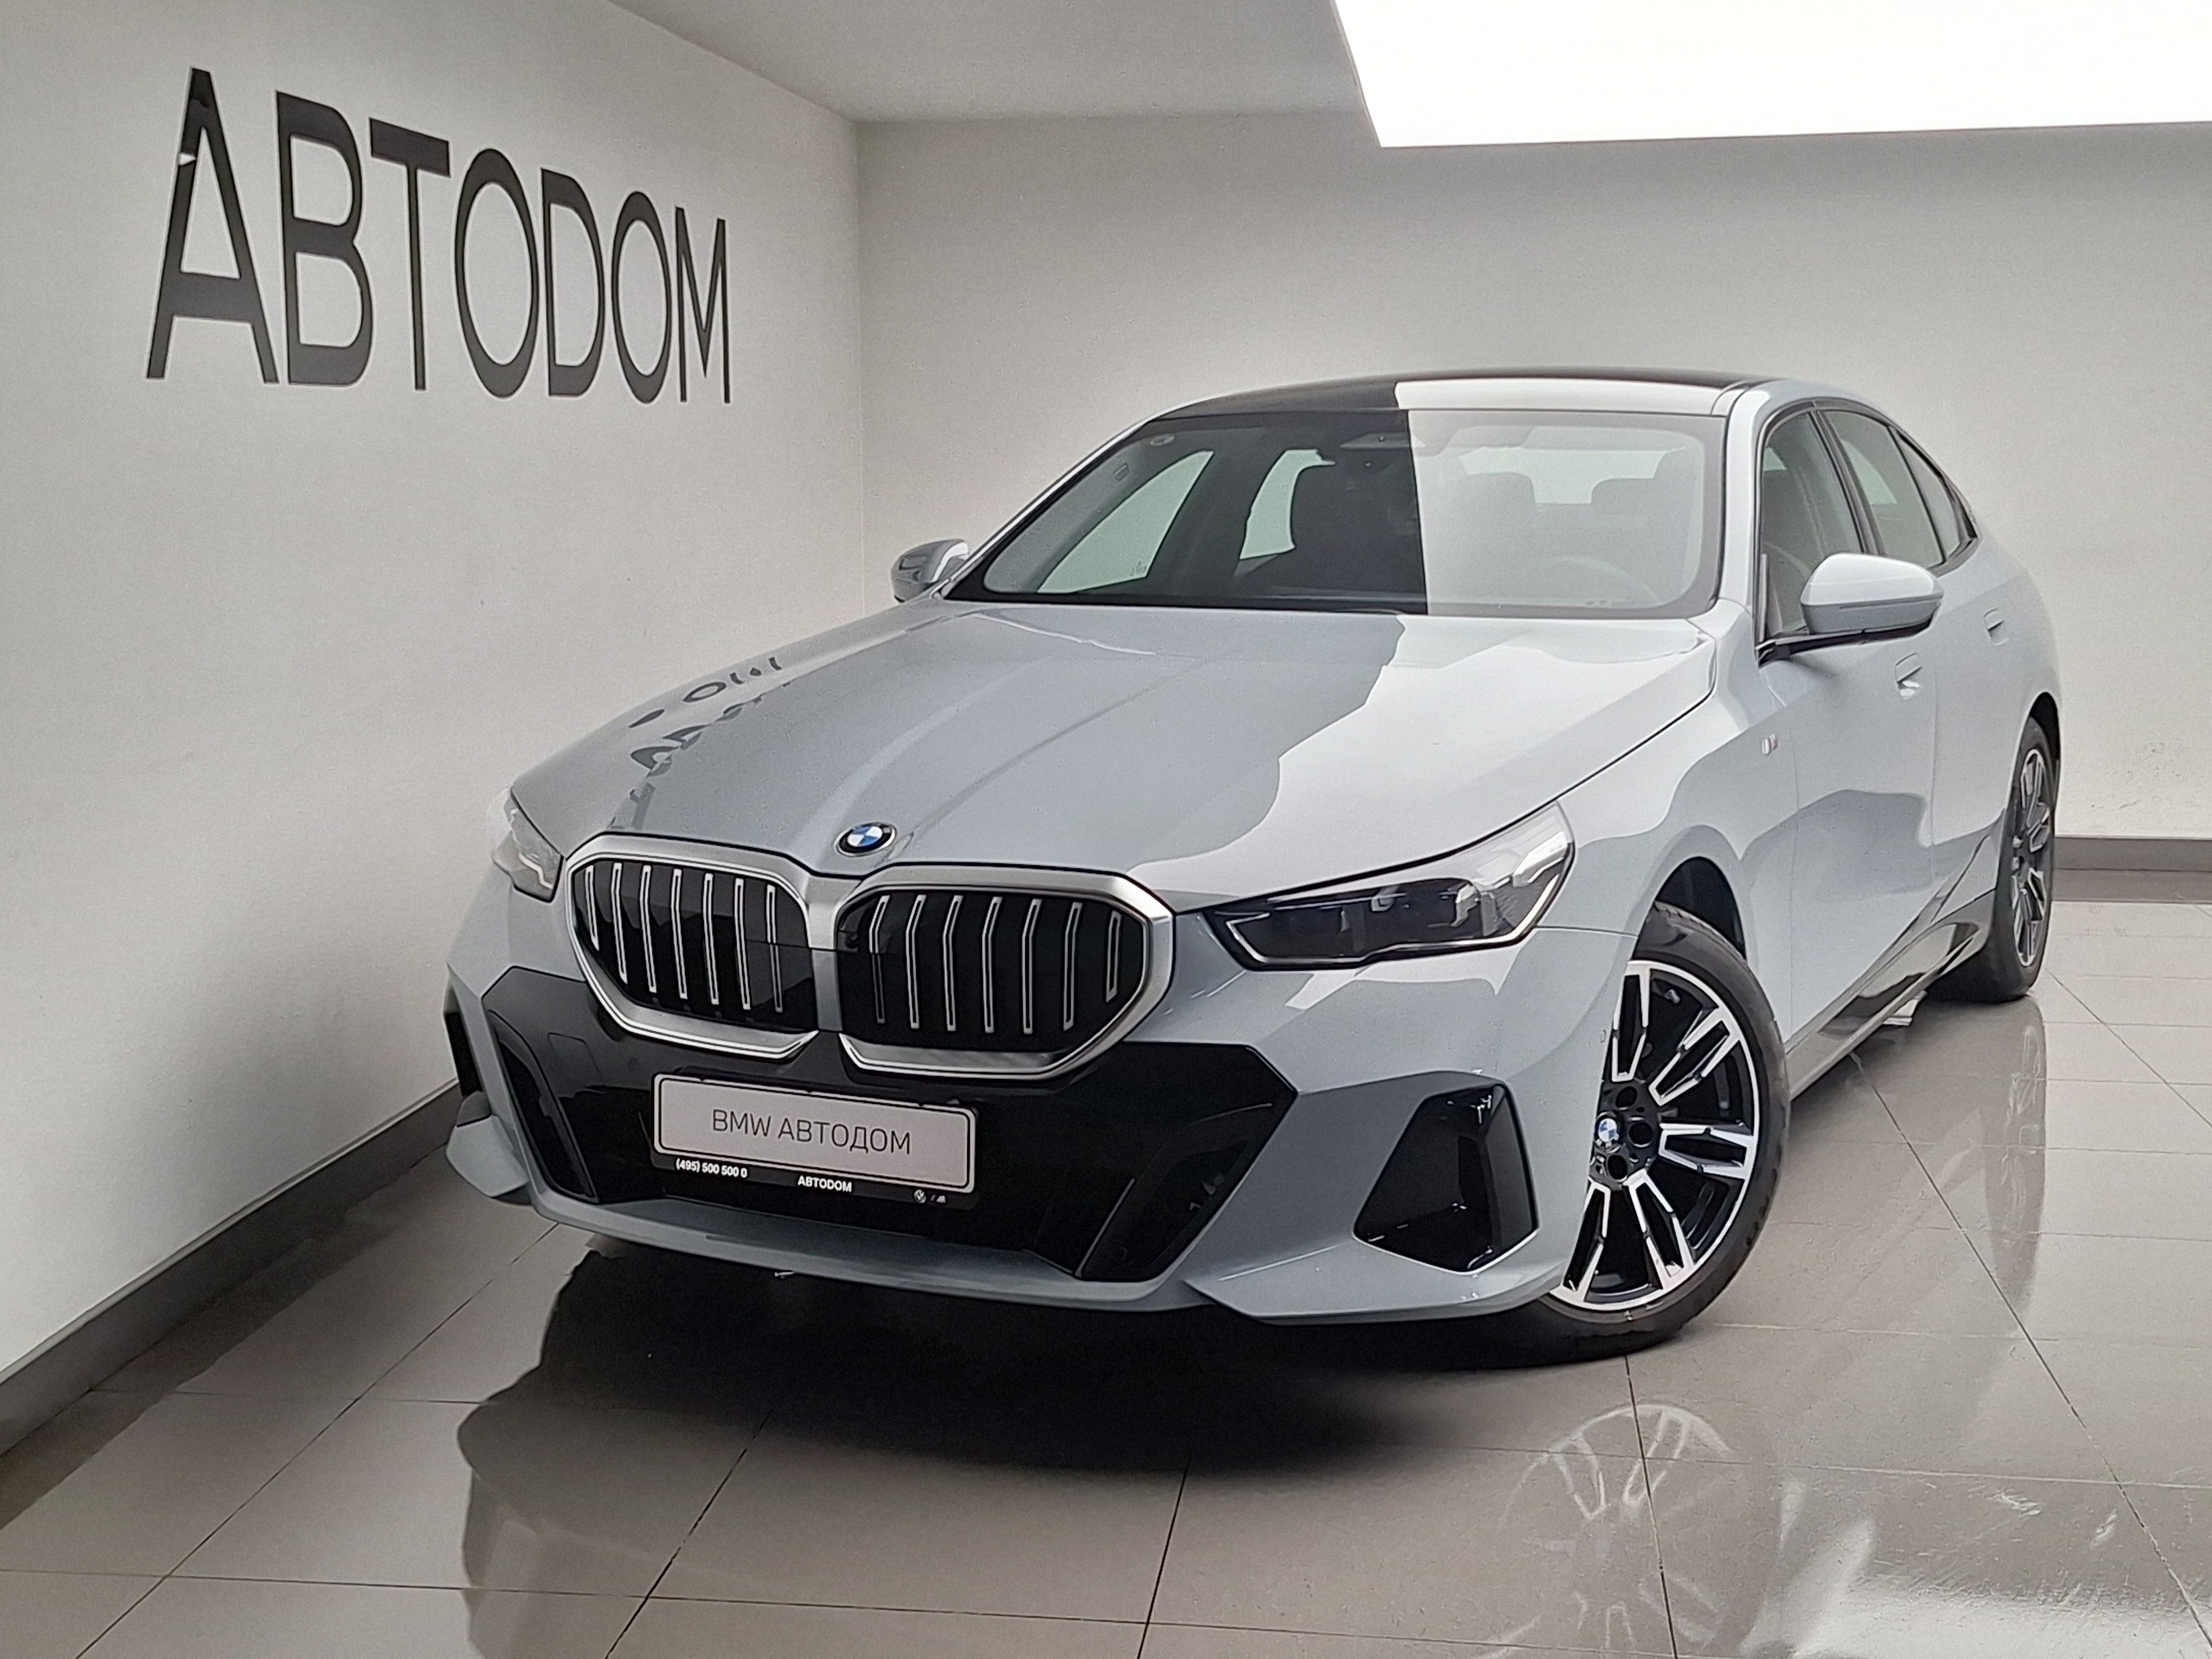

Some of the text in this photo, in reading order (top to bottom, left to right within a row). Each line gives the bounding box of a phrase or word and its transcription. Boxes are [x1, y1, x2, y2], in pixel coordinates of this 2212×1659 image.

[712, 1109, 911, 1155] BMW АВТОДОМ
[676, 1158, 748, 1178] (495) 500 500 0
